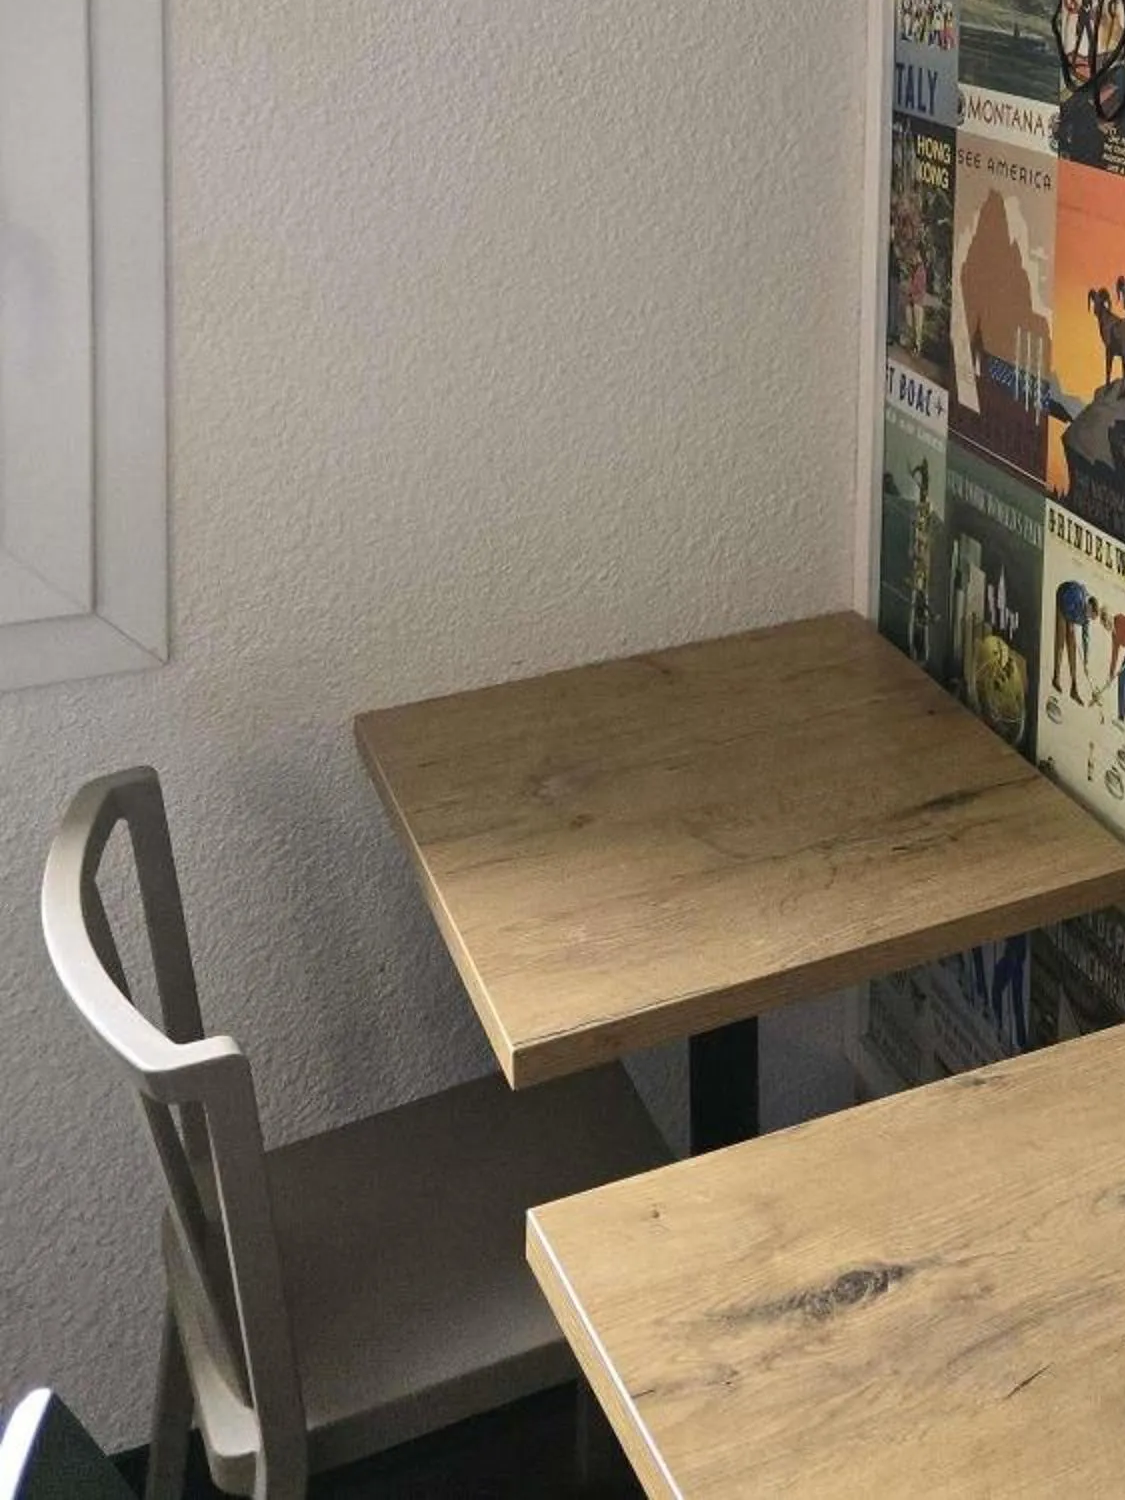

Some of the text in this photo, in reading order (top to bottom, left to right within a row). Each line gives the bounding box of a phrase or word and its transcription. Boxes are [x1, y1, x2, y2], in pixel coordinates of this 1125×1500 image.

[896, 62, 938, 116] TALY
[968, 96, 1045, 137] MONTANA
[917, 134, 951, 164] HONG
[958, 150, 1052, 188] SEE AMERICA
